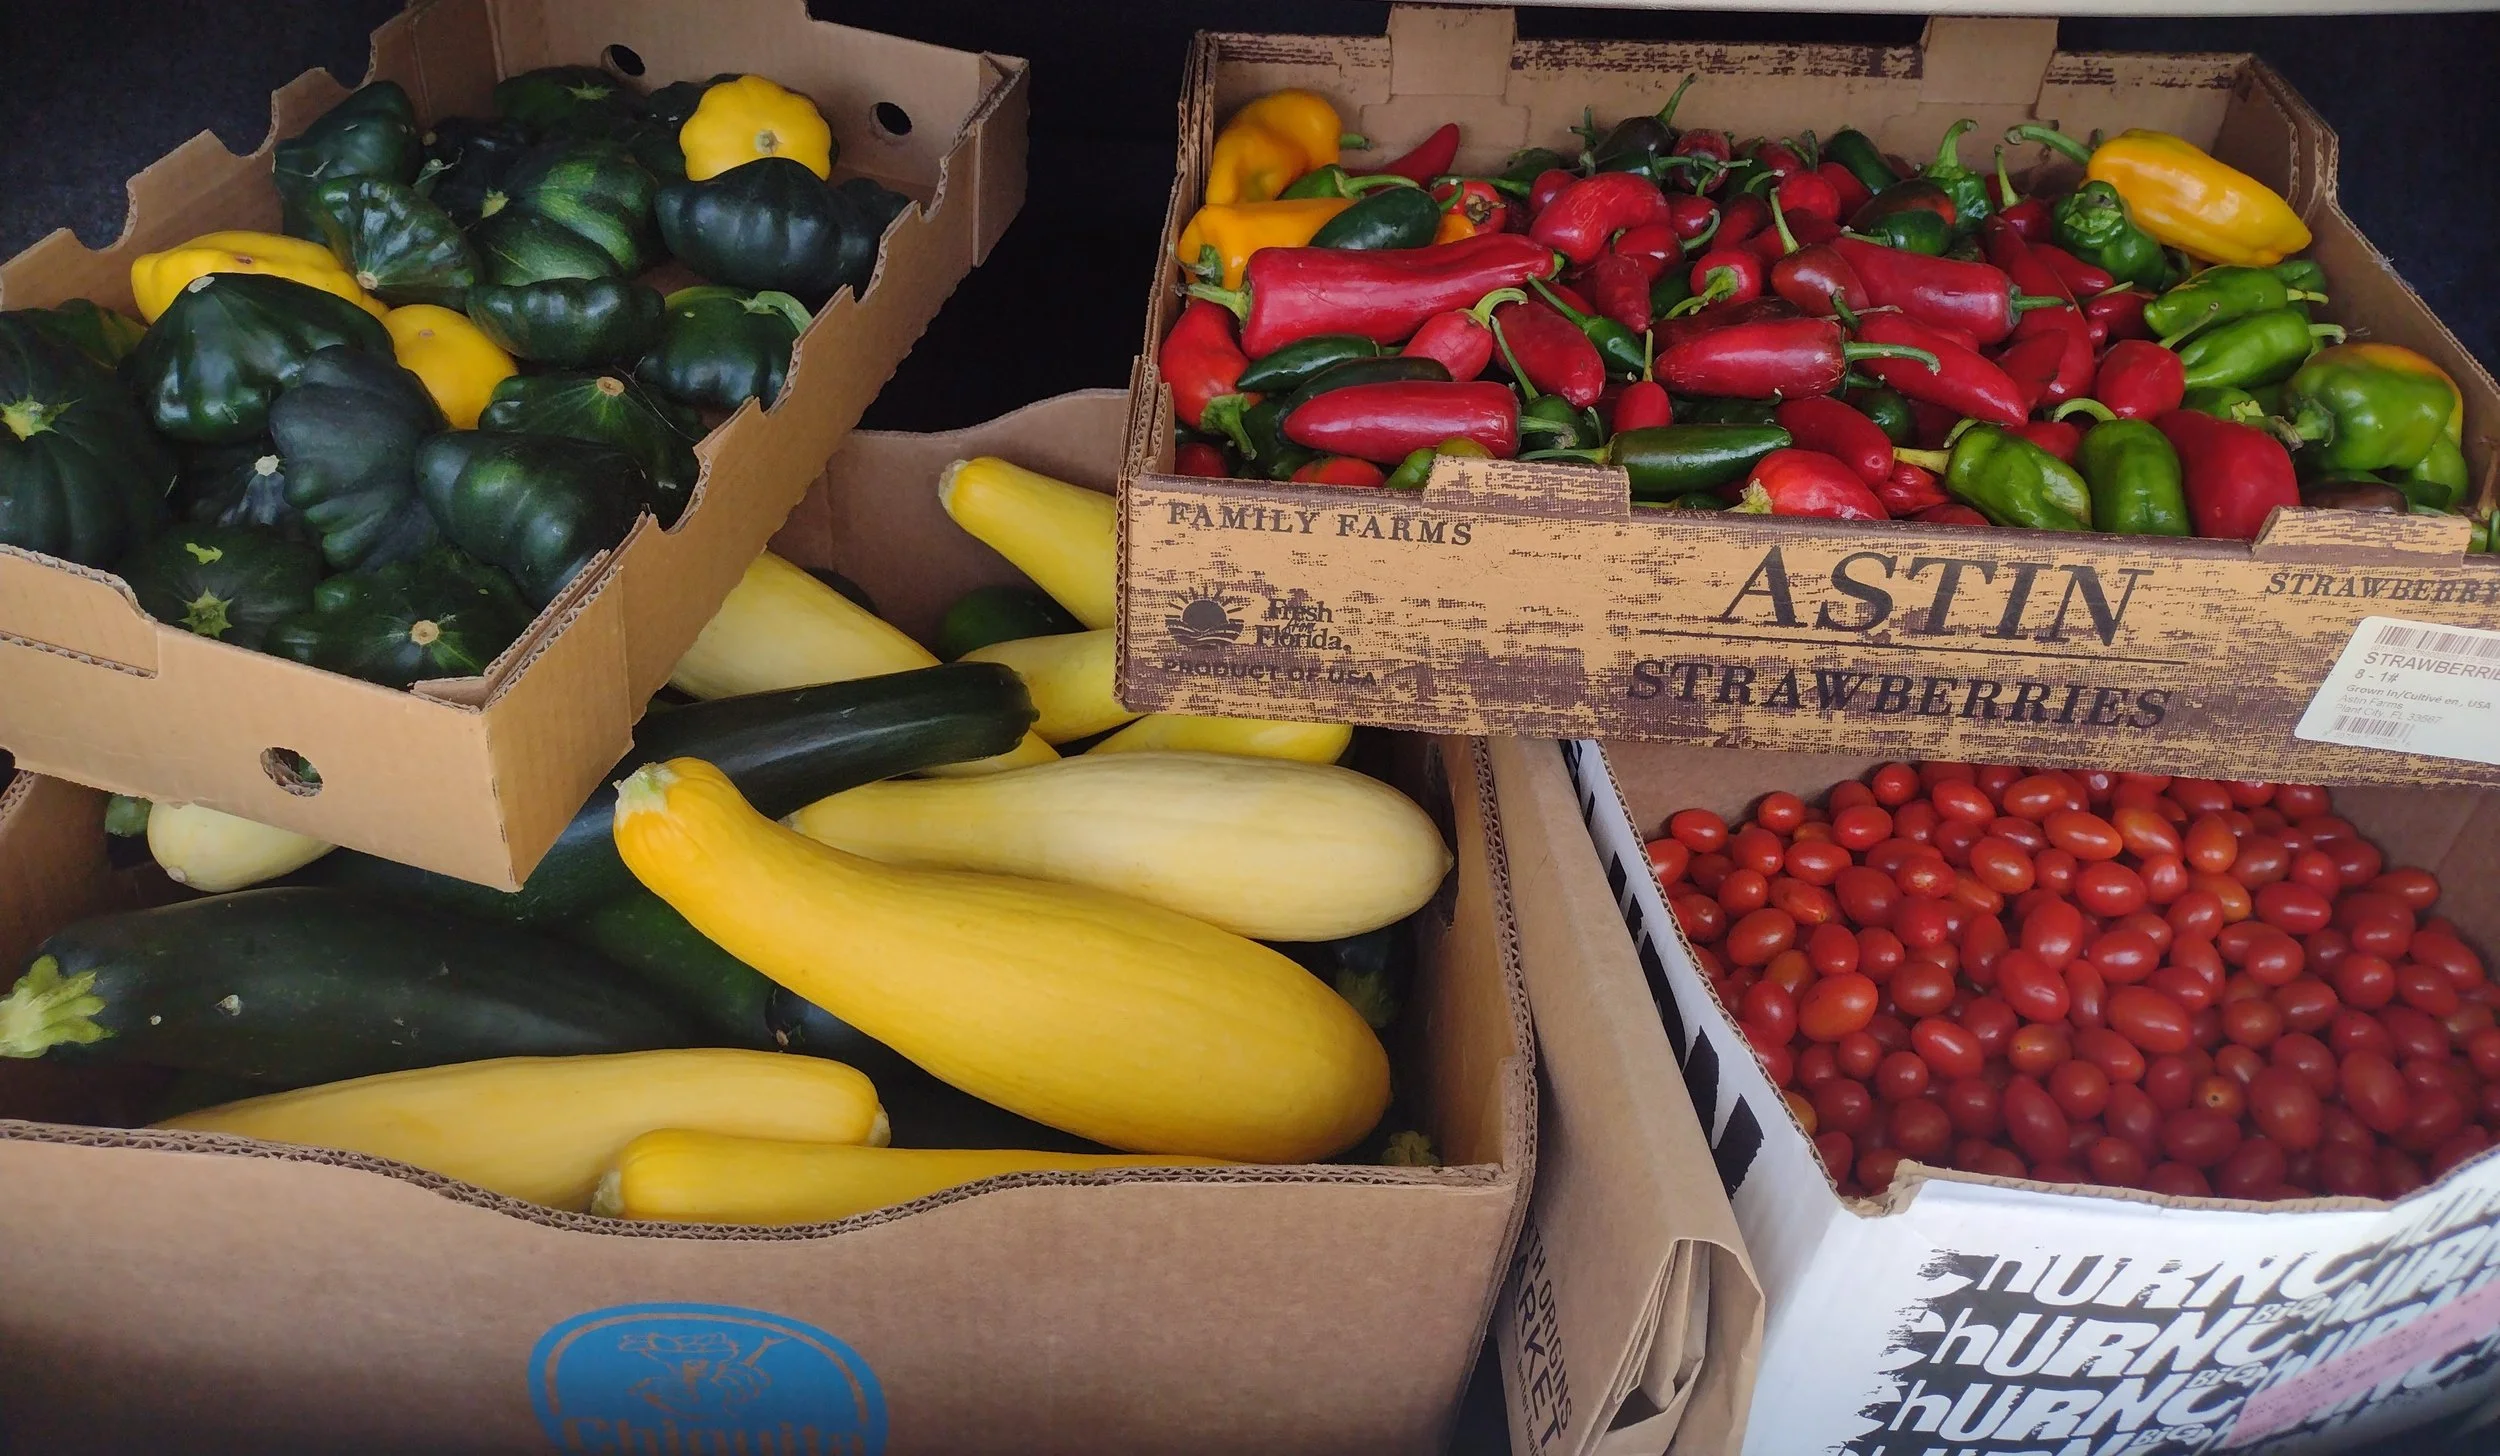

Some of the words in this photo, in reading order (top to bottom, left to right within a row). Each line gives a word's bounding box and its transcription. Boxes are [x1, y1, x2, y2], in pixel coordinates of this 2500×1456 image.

[1167, 502, 1319, 535] FAMILY
[1336, 513, 1473, 547] FARMS
[1708, 545, 2154, 647] ASTIN
[1267, 598, 1334, 623] Fresh
[1164, 659, 1279, 681] PRODUCT
[1288, 667, 1320, 683] OF
[1328, 668, 1377, 686] USA
[1626, 659, 2173, 729] STRAWBERRIES
[2339, 694, 2367, 705] Astin
[2370, 698, 2404, 710] Farms
[2346, 684, 2384, 696] Grown
[2467, 700, 2493, 710] USA
[2335, 703, 2362, 714] Plant
[2390, 711, 2405, 720] FL
[1540, 1279, 1572, 1431] ORIGINS
